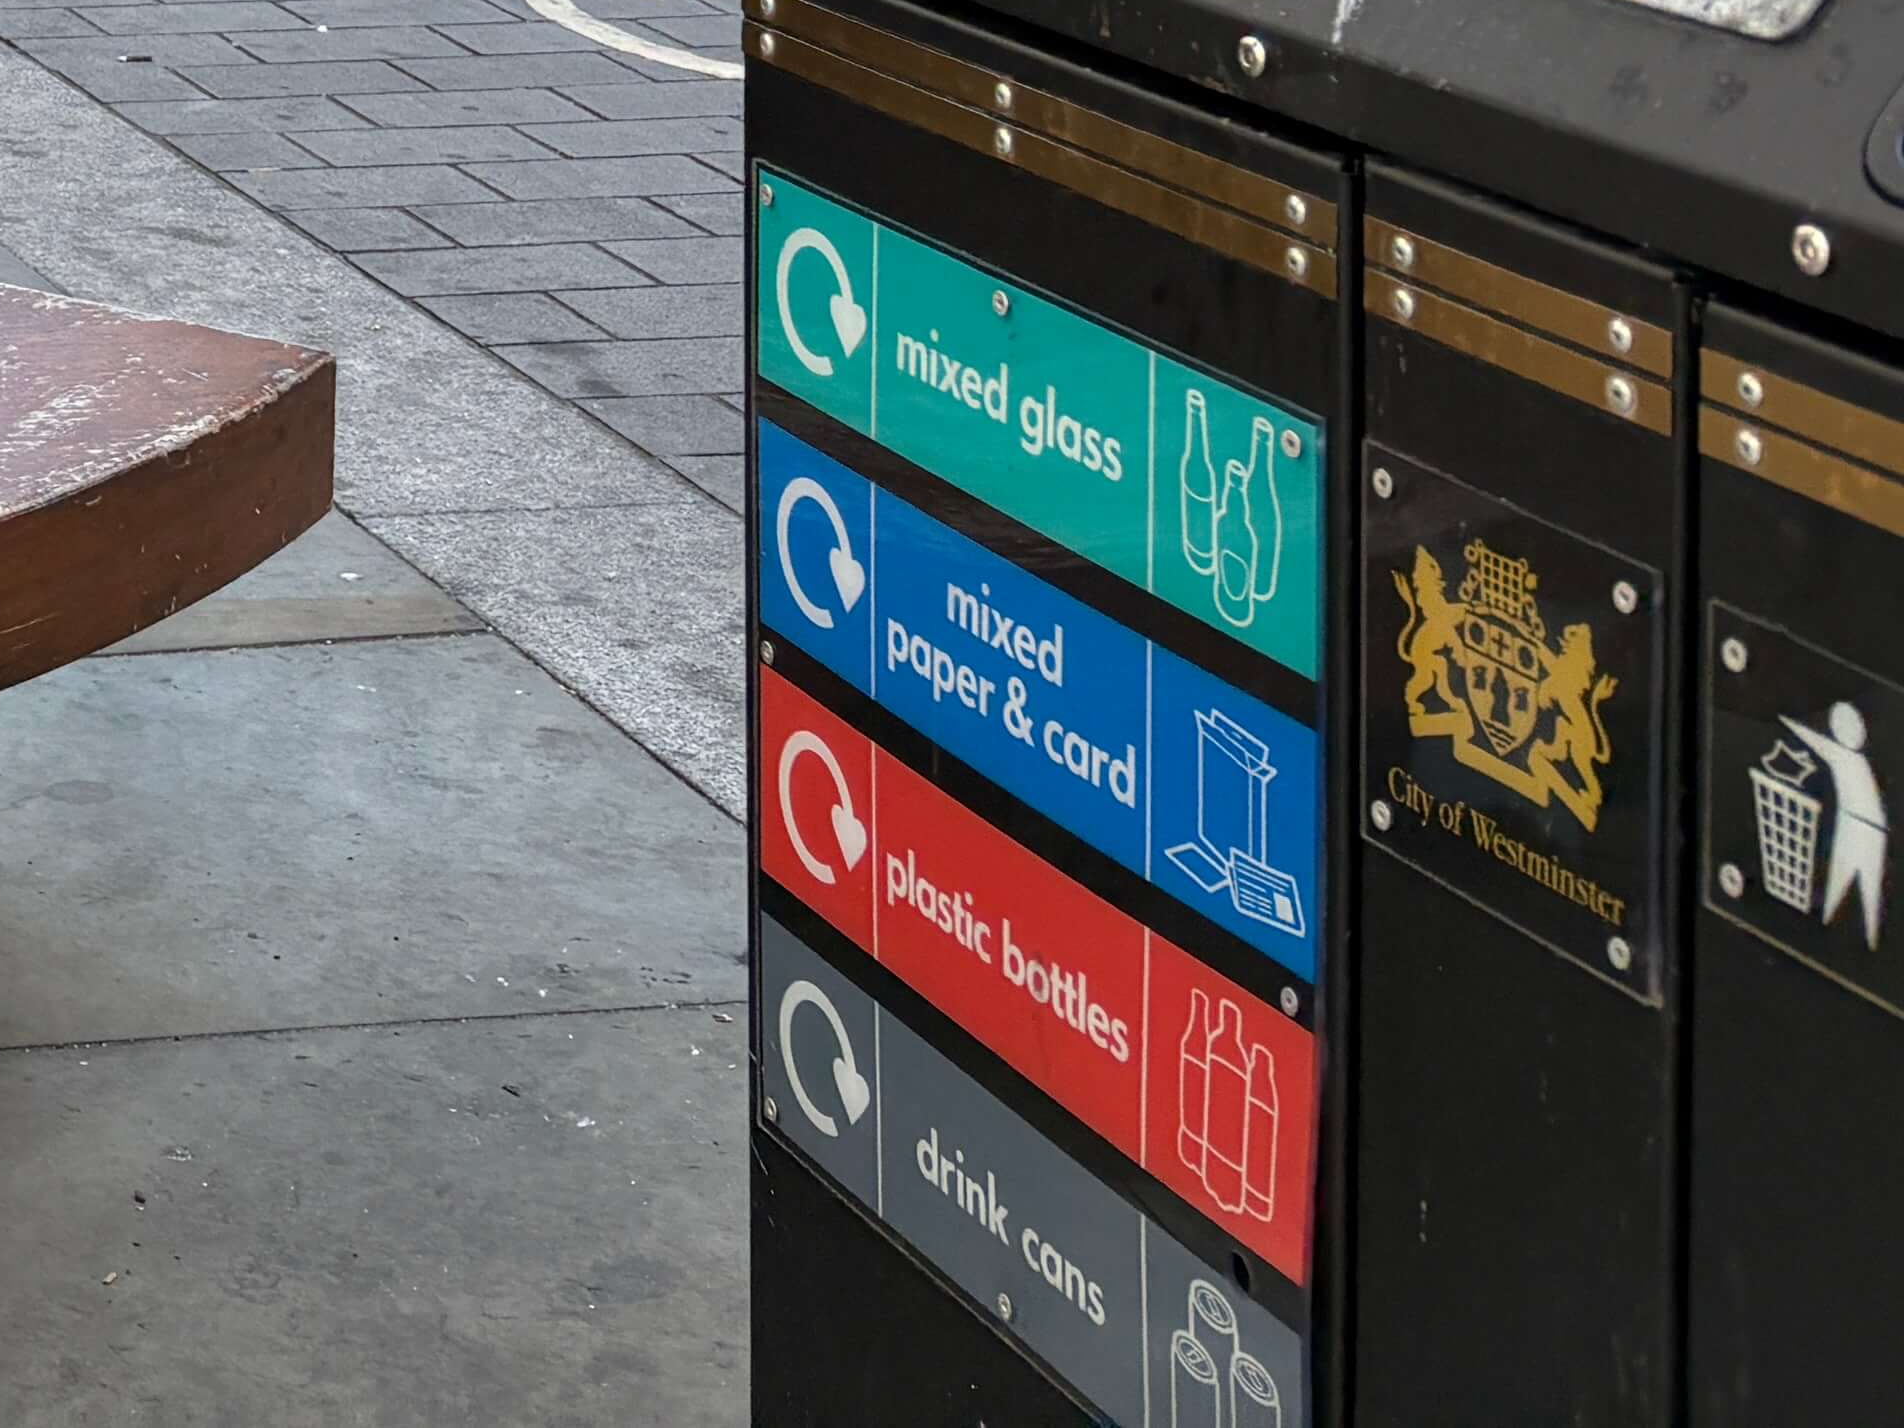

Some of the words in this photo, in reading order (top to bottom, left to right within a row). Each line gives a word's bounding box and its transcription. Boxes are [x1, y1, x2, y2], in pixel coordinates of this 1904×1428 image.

[897, 328, 1009, 425] mixed
[1019, 385, 1124, 482] glass
[887, 617, 996, 717] paper
[1002, 676, 1036, 748] &
[1043, 720, 1136, 809] card
[946, 582, 1063, 687] mixed
[1387, 766, 1435, 828] City
[1438, 799, 1468, 837] of
[1470, 806, 1626, 926] Westminster
[887, 849, 992, 965] plastic
[1002, 918, 1129, 1063] bottles
[916, 1127, 1010, 1246] drink
[1021, 1227, 1106, 1326] cans
